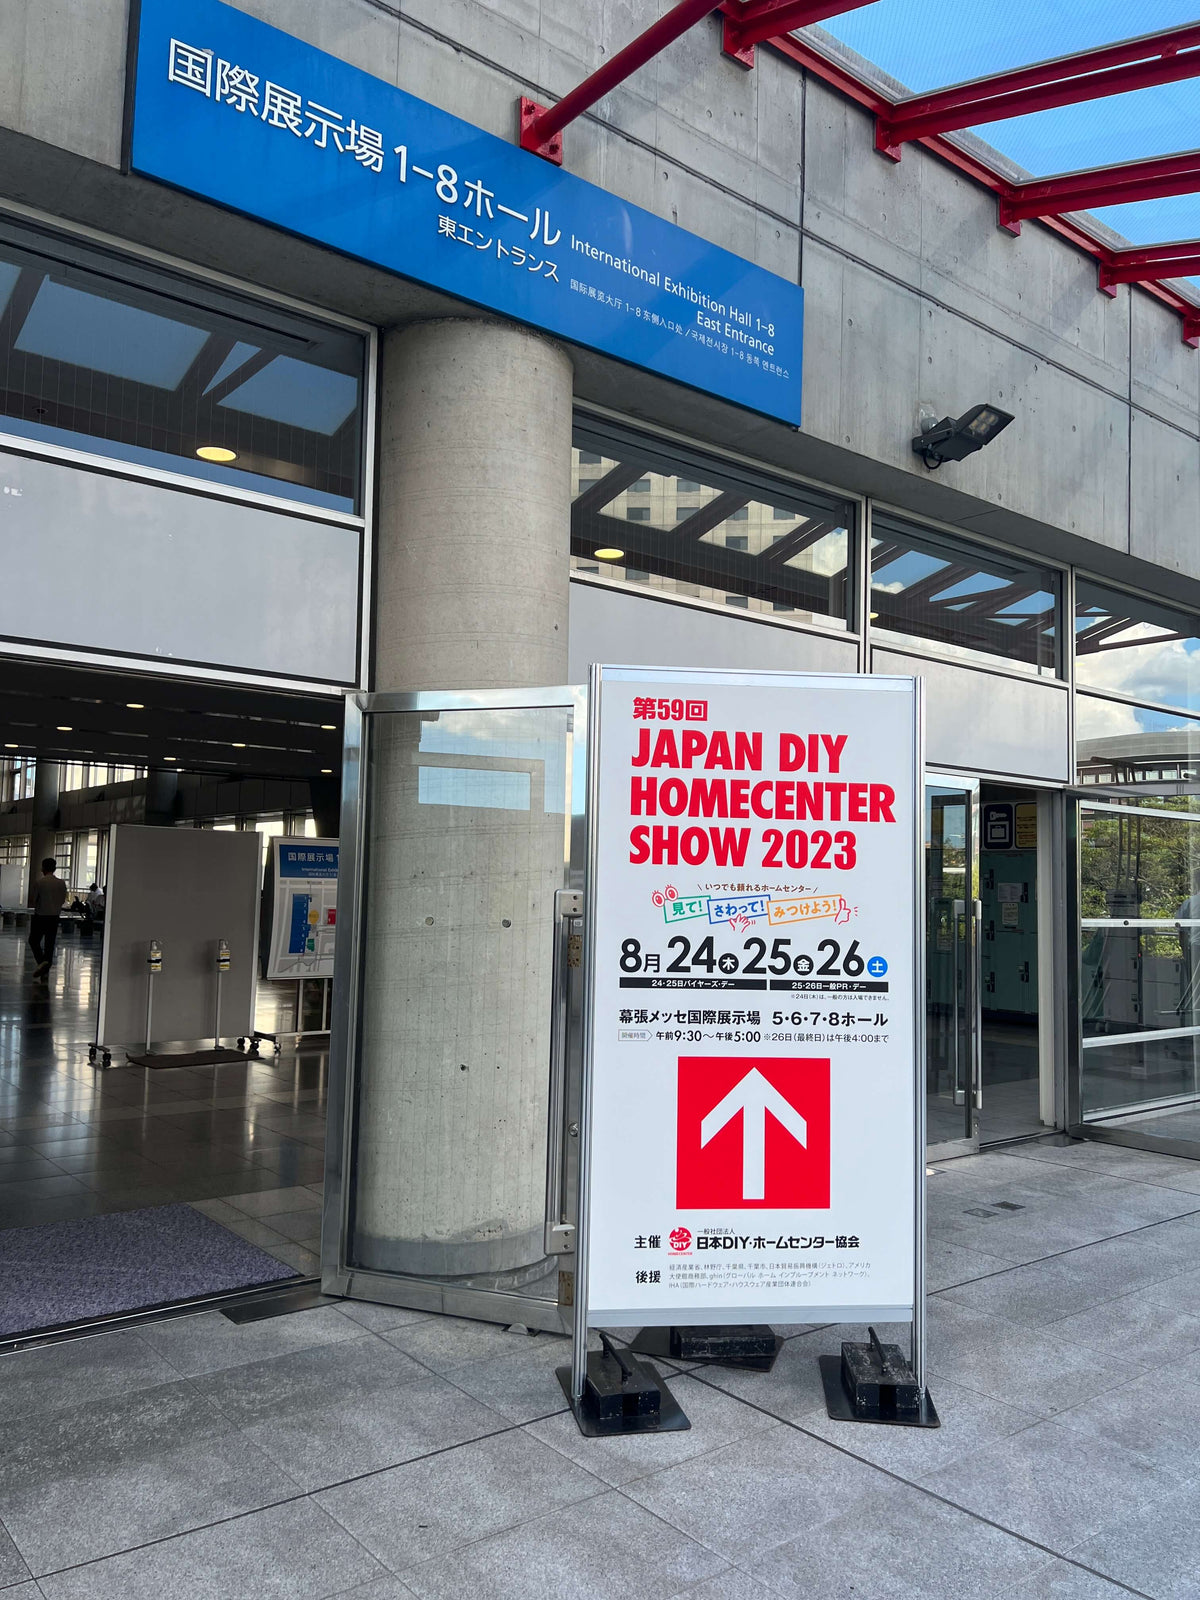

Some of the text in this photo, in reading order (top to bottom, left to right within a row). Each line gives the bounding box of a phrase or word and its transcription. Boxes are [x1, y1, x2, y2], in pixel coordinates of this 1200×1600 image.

[168, 37, 384, 173] 国際展示場
[437, 214, 560, 283] 東エントランス
[571, 234, 660, 287] International
[664, 276, 726, 317] Exhibition
[729, 305, 752, 328] Hall
[570, 278, 622, 310] 国际展览大厅
[643, 309, 683, 336] 东侧入口处
[696, 310, 775, 356] East Entrance
[633, 697, 708, 721] 第59回
[631, 727, 848, 773] JAPAN DIY
[630, 776, 897, 823] HOMECENTER
[629, 824, 857, 870] SHOW 2023
[705, 883, 812, 893] いつでも頼れるホームセンター
[619, 1009, 761, 1026] 幕張メッセ国際展示場
[634, 1234, 661, 1249] 主催
[673, 1241, 687, 1249] DIY
[697, 1228, 736, 1236] 一般社団法人
[697, 1235, 860, 1250] 日本DIY・ホームセンター協会
[635, 1270, 661, 1284] 後援
